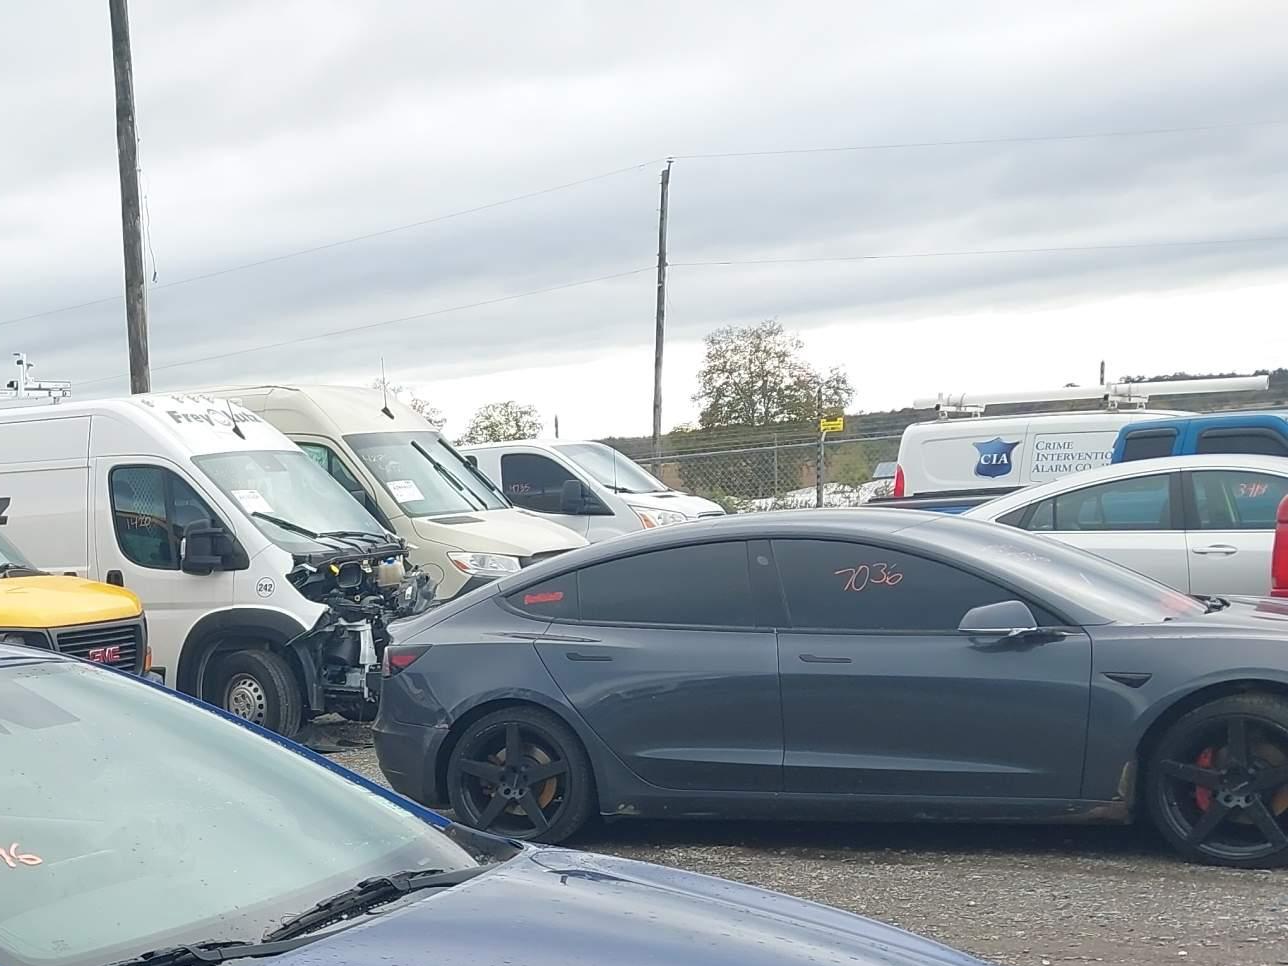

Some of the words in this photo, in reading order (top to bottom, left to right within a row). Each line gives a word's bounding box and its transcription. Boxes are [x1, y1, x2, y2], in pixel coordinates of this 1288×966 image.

[1035, 440, 1073, 451] CRIME
[980, 453, 1009, 465] CIA
[1035, 451, 1113, 462] INTERVENTIO
[1032, 462, 1072, 473] ALARM
[834, 562, 904, 592] 7036
[258, 582, 273, 593] 242
